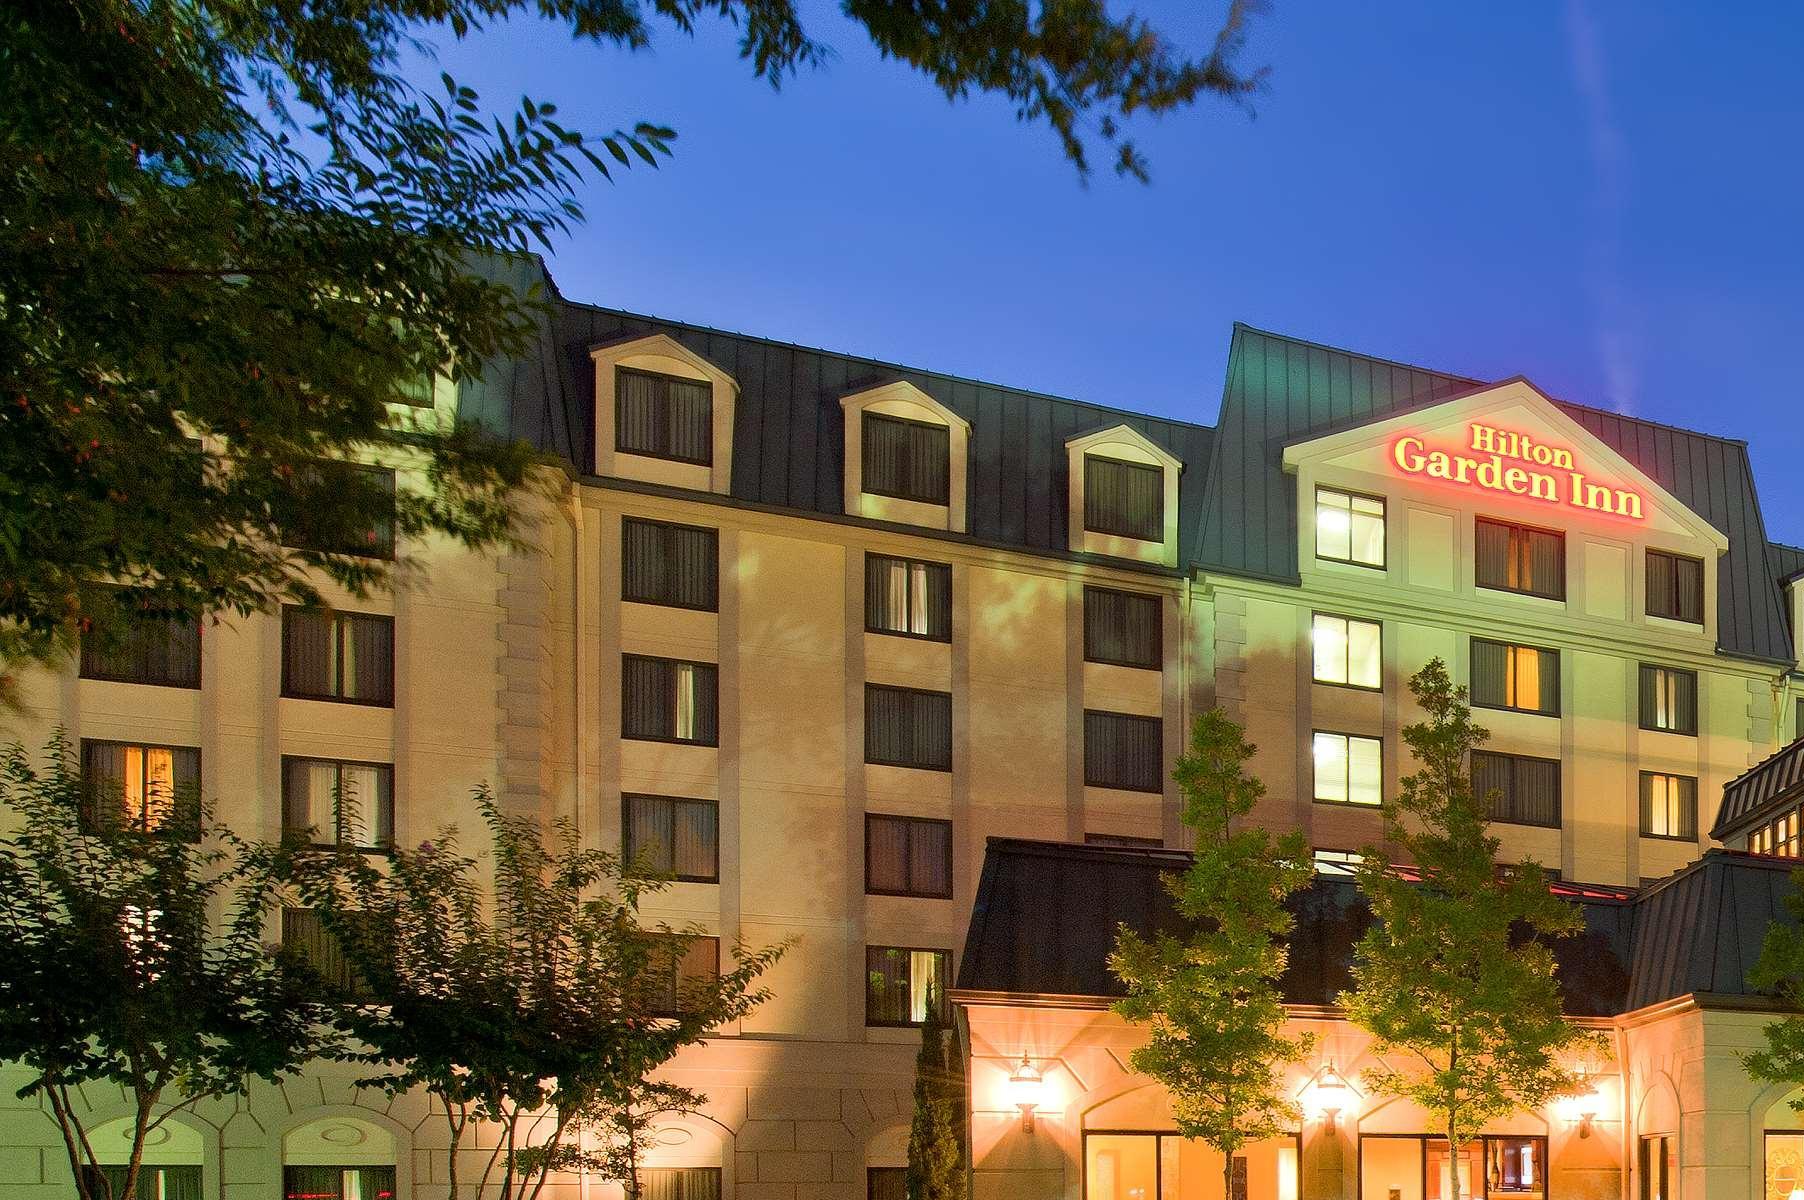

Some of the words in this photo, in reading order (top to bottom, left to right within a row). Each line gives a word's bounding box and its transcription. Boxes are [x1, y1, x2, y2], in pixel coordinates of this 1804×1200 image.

[1394, 436, 1560, 502] Garden
[1568, 471, 1645, 519] Inn
[1470, 423, 1575, 471] Hilton
